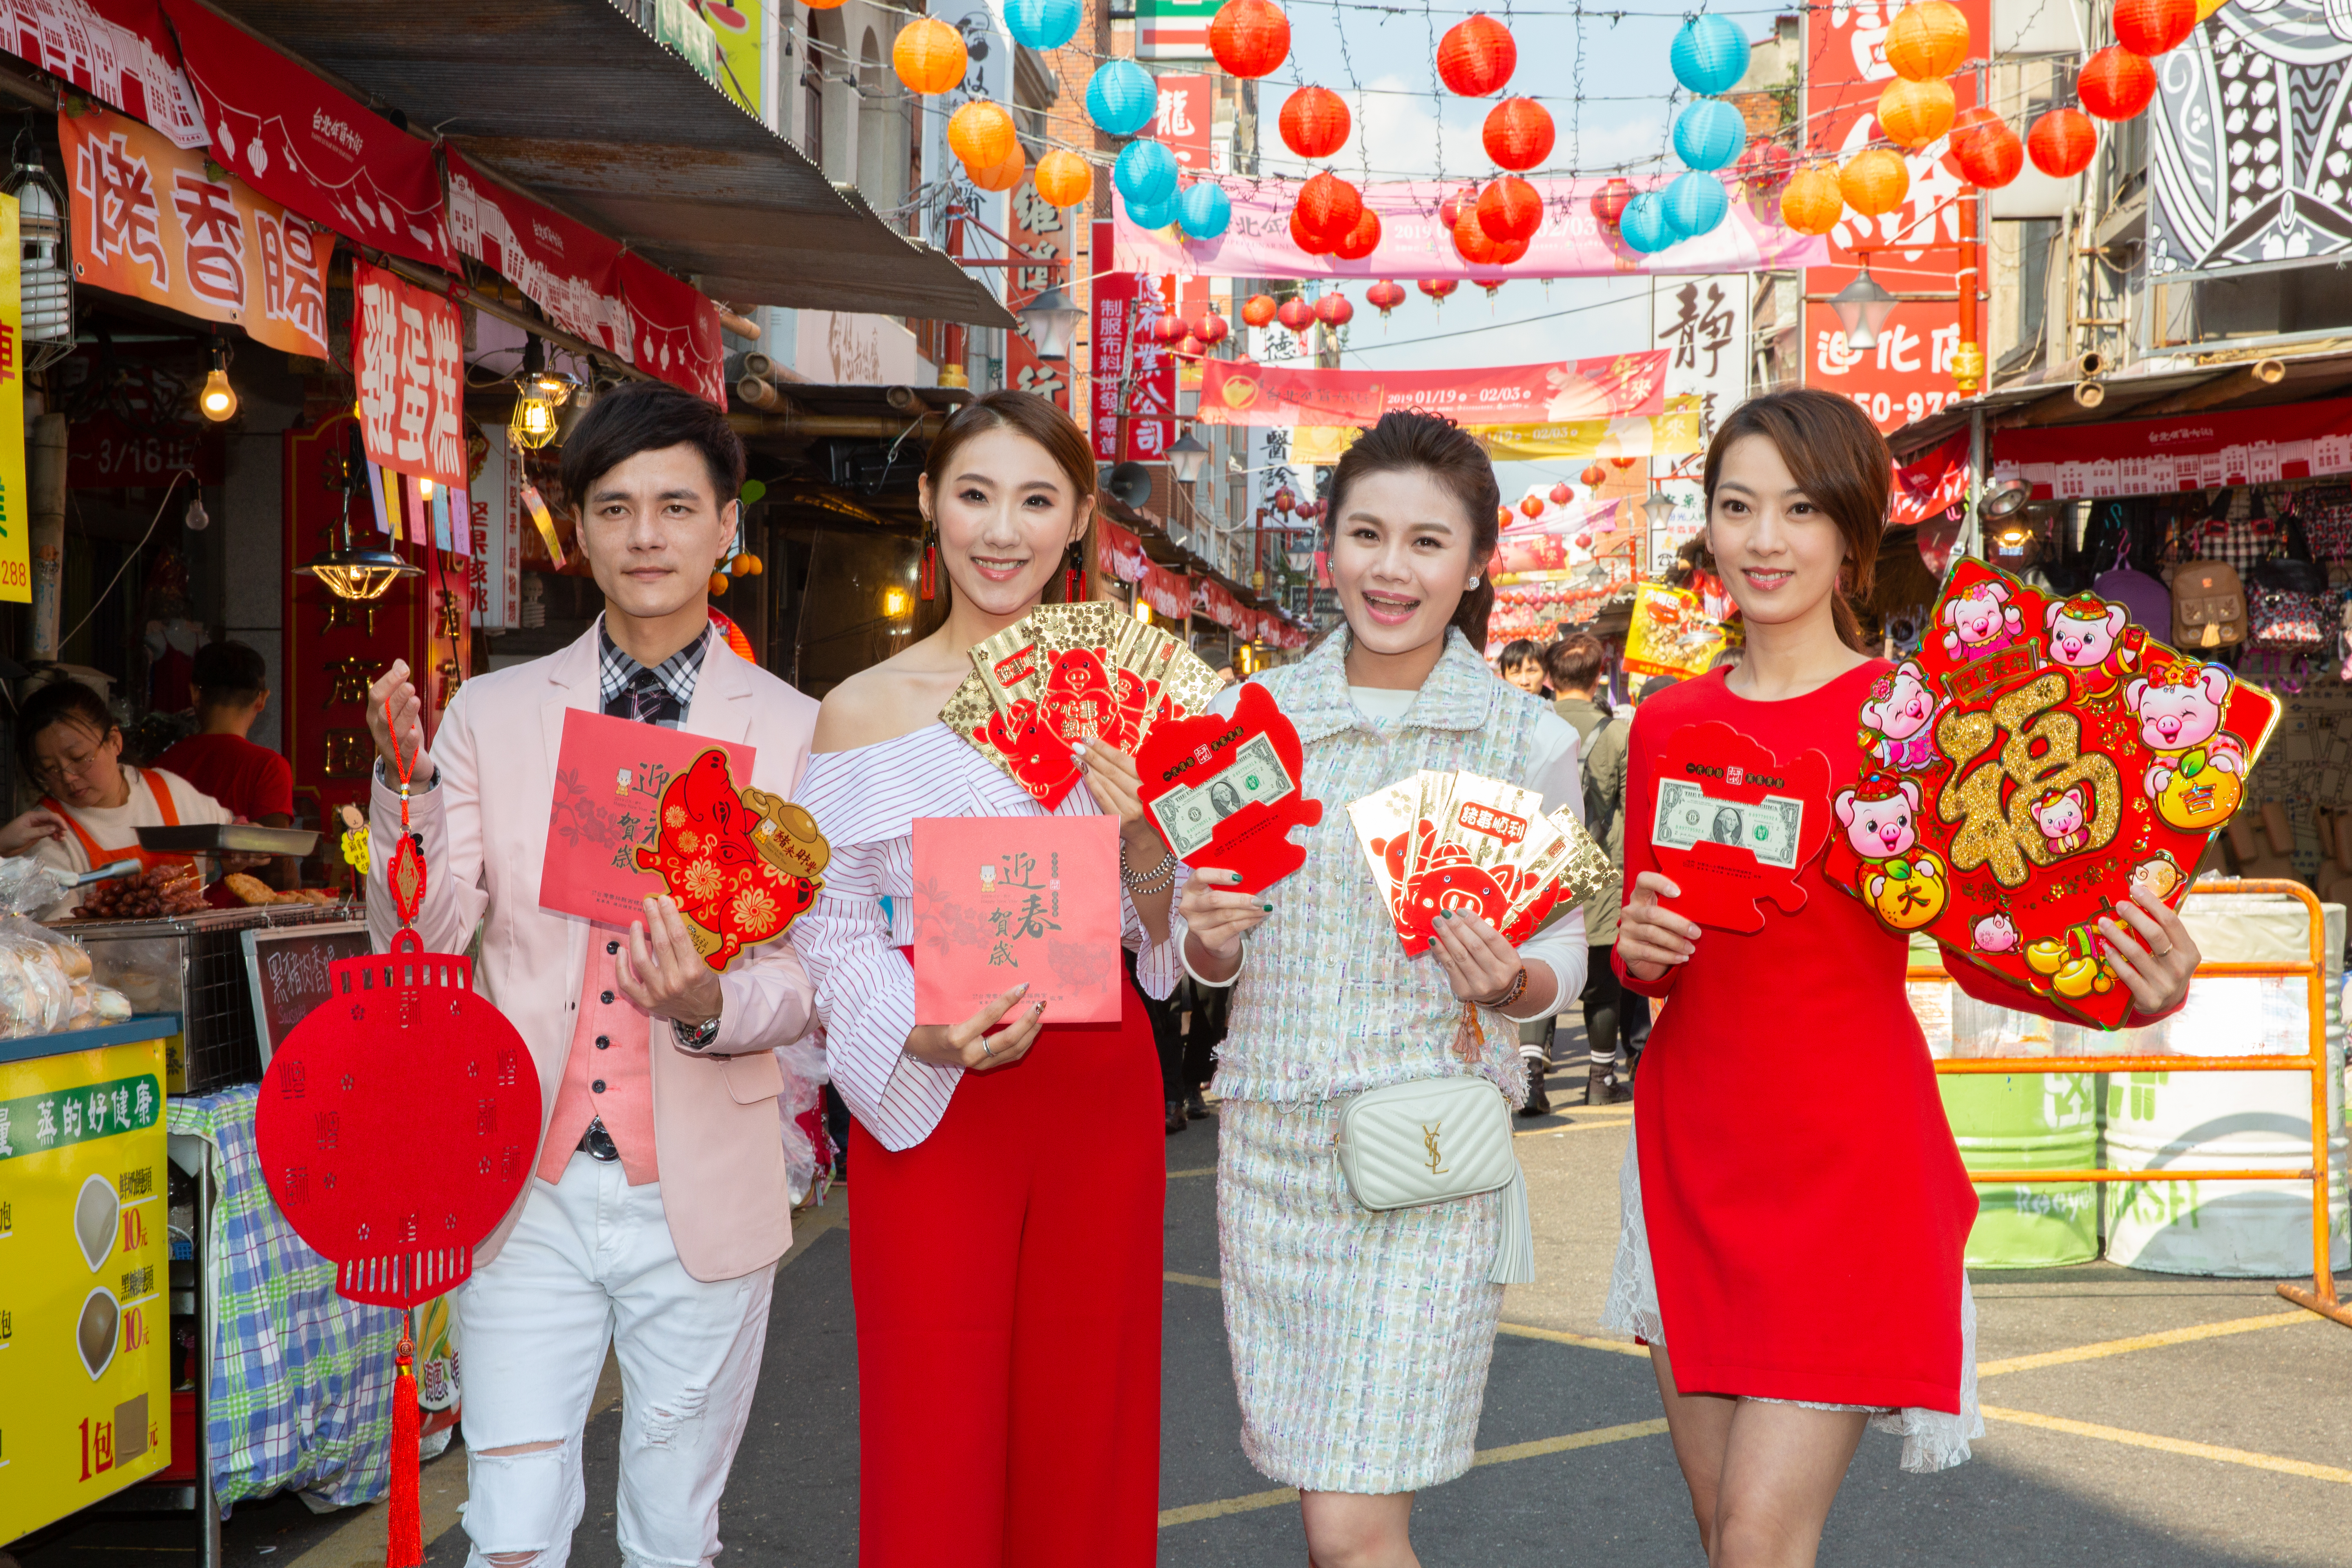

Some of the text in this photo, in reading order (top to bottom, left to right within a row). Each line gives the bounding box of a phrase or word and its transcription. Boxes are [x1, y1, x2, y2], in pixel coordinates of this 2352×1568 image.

[313, 106, 363, 155] 台北年貨大街
[77, 131, 328, 350] 烤香腸
[1394, 225, 1432, 239] 2019
[1536, 217, 1597, 237] 02/03
[360, 282, 461, 477] 雞蛋糕
[1479, 387, 1521, 402] 02/03
[1388, 390, 1457, 404] 2019 01/19
[1644, 588, 1679, 610] 大嘴巴
[1936, 672, 2124, 889] 福
[2181, 783, 2216, 815] 吉
[1461, 805, 1525, 840] 諸事順利
[998, 852, 1062, 941] 迎春
[1898, 882, 1930, 915] 大
[36, 1080, 153, 1147] 蒸的好健康
[119, 1167, 152, 1200] 鮮奶饅頭
[121, 1264, 154, 1301] 黑糖饅頭
